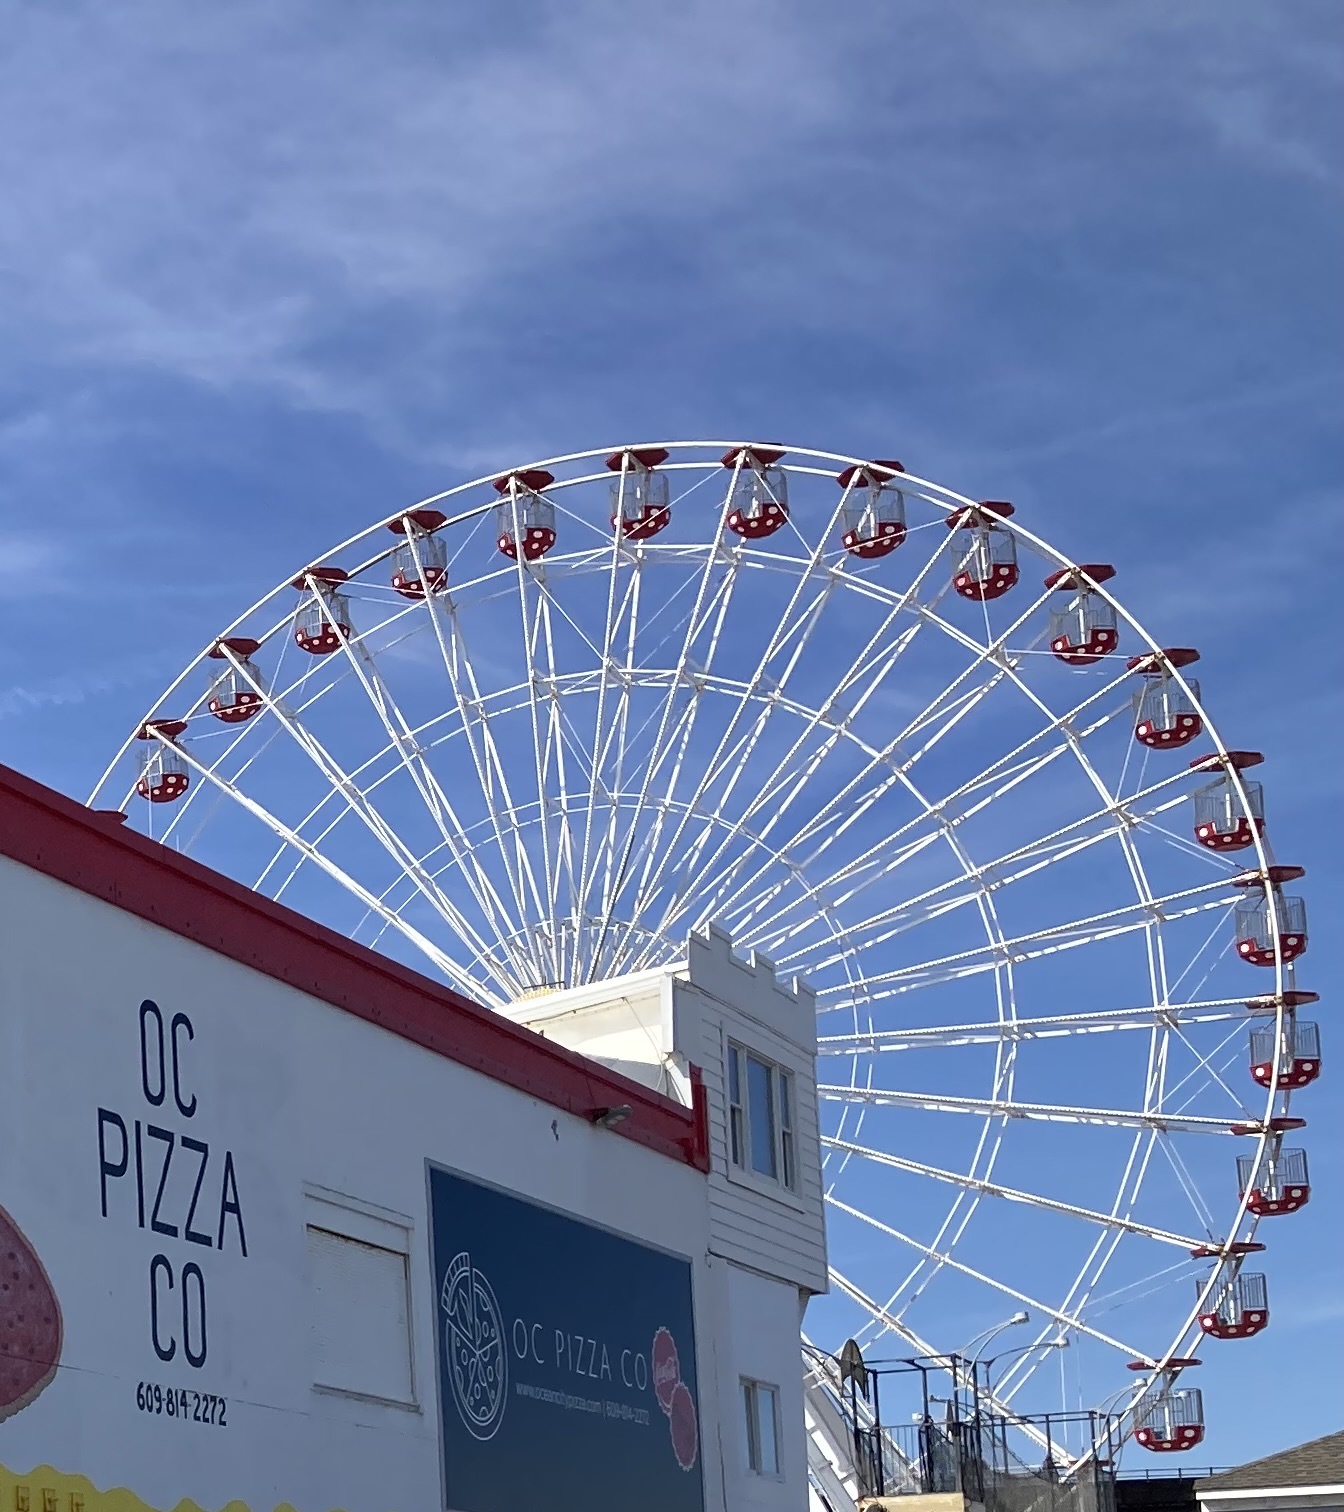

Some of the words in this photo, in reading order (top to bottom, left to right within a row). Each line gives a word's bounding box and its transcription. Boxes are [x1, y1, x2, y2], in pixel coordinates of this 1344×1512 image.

[139, 999, 197, 1118] OC
[97, 1107, 248, 1257] PIZZA
[150, 1253, 207, 1368] CO
[513, 1319, 544, 1364] OC
[555, 1330, 612, 1382] PIZZA
[621, 1350, 647, 1390] CO
[137, 1381, 227, 1426] 609-814-2272
